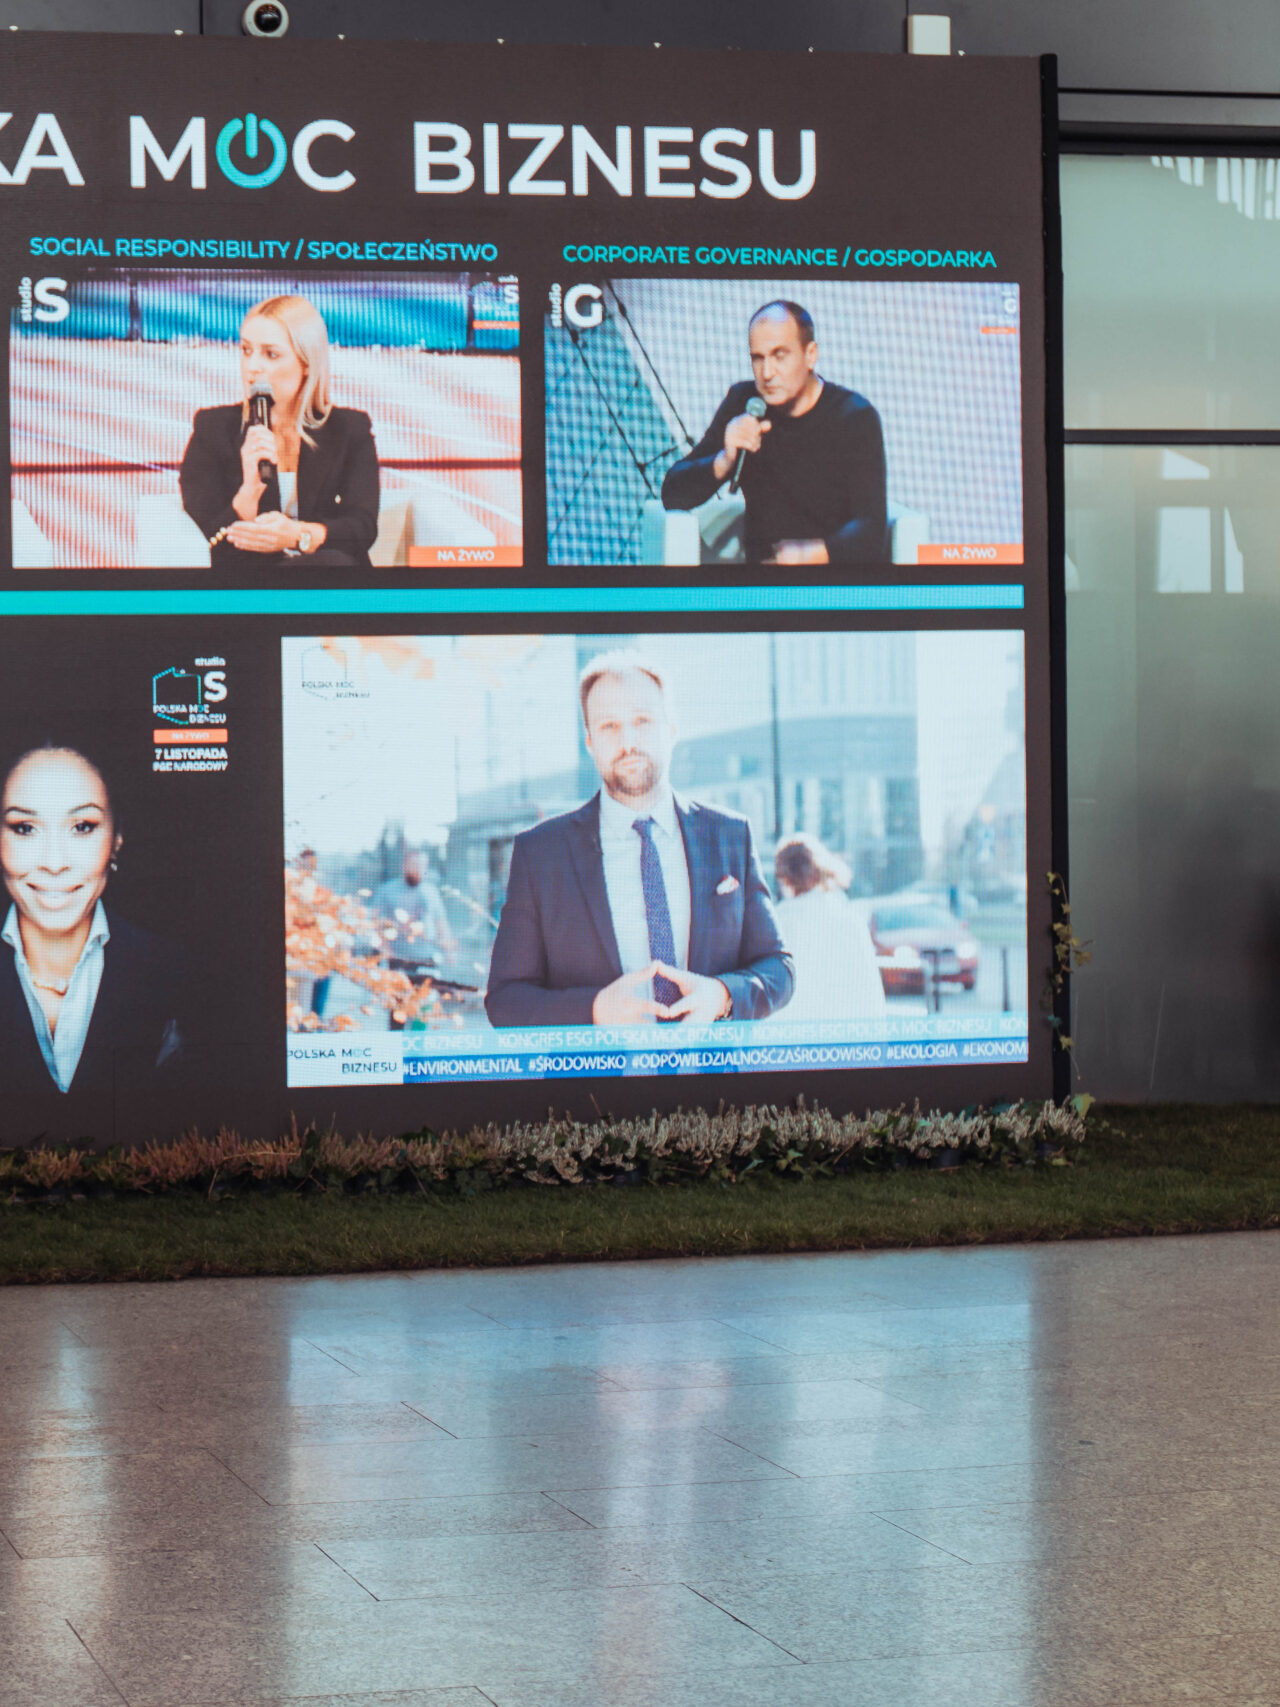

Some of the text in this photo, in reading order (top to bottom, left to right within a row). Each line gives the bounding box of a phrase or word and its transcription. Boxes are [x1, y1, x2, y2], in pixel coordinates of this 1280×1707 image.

[129, 113, 357, 192] MOC
[413, 121, 817, 200] BIZNESU
[29, 237, 111, 257] SOCIAL
[115, 239, 292, 260] RESPONSIBILITY
[307, 239, 499, 262] SPOŁECZEŃSTWO
[562, 245, 690, 265] CORPORATE
[694, 246, 838, 266] GOVERNANCE
[854, 248, 998, 268] GOSPODARKA
[18, 276, 70, 322] studio S
[549, 283, 603, 328] studio G
[437, 549, 456, 562] NA
[942, 547, 961, 559] NA
[204, 670, 228, 703] S
[154, 747, 228, 760] 7 LISTOPADA
[341, 1062, 398, 1074] BIZNESU
